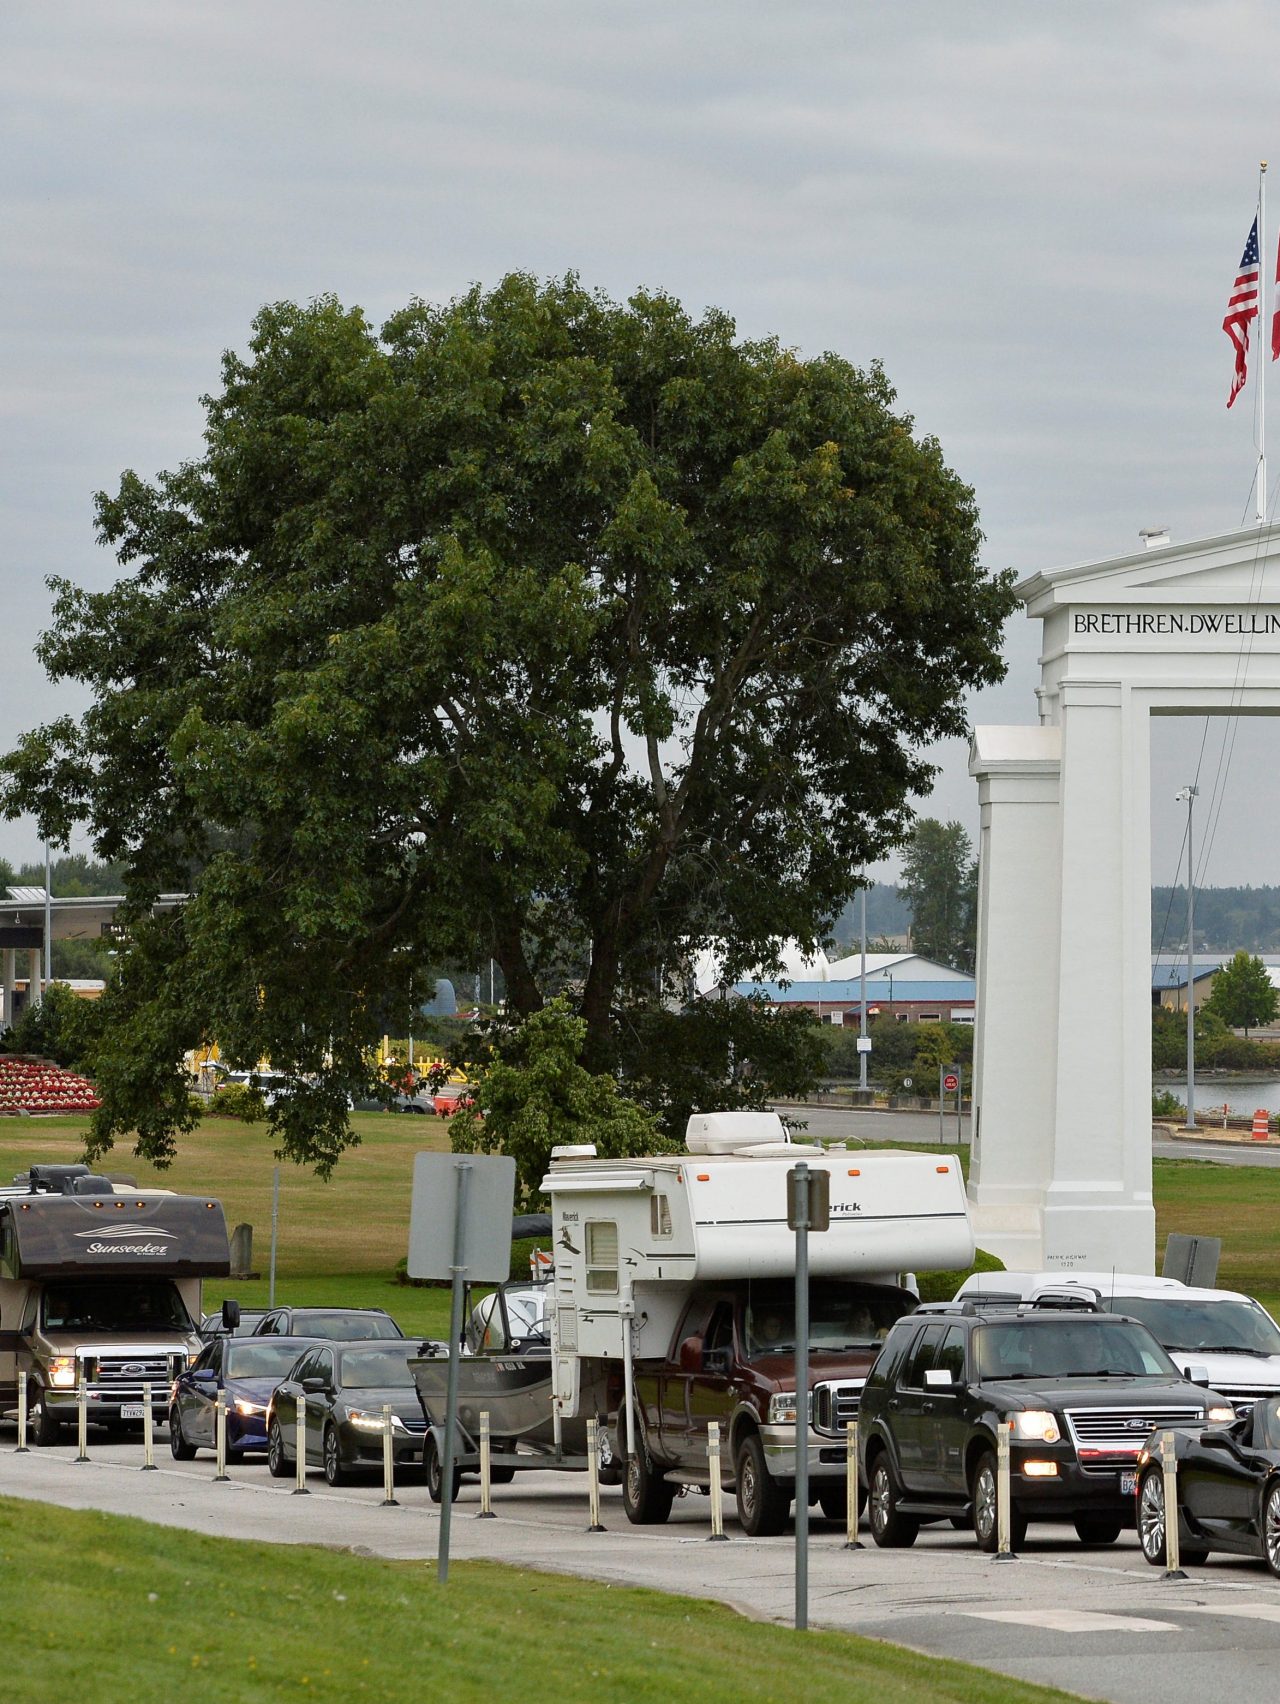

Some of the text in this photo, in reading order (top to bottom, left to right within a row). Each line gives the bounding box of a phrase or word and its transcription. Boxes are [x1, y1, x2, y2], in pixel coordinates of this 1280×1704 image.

[1074, 614, 1184, 634] BRETHREN
[828, 1202, 861, 1212] erick
[86, 1242, 168, 1254] Sunseeker
